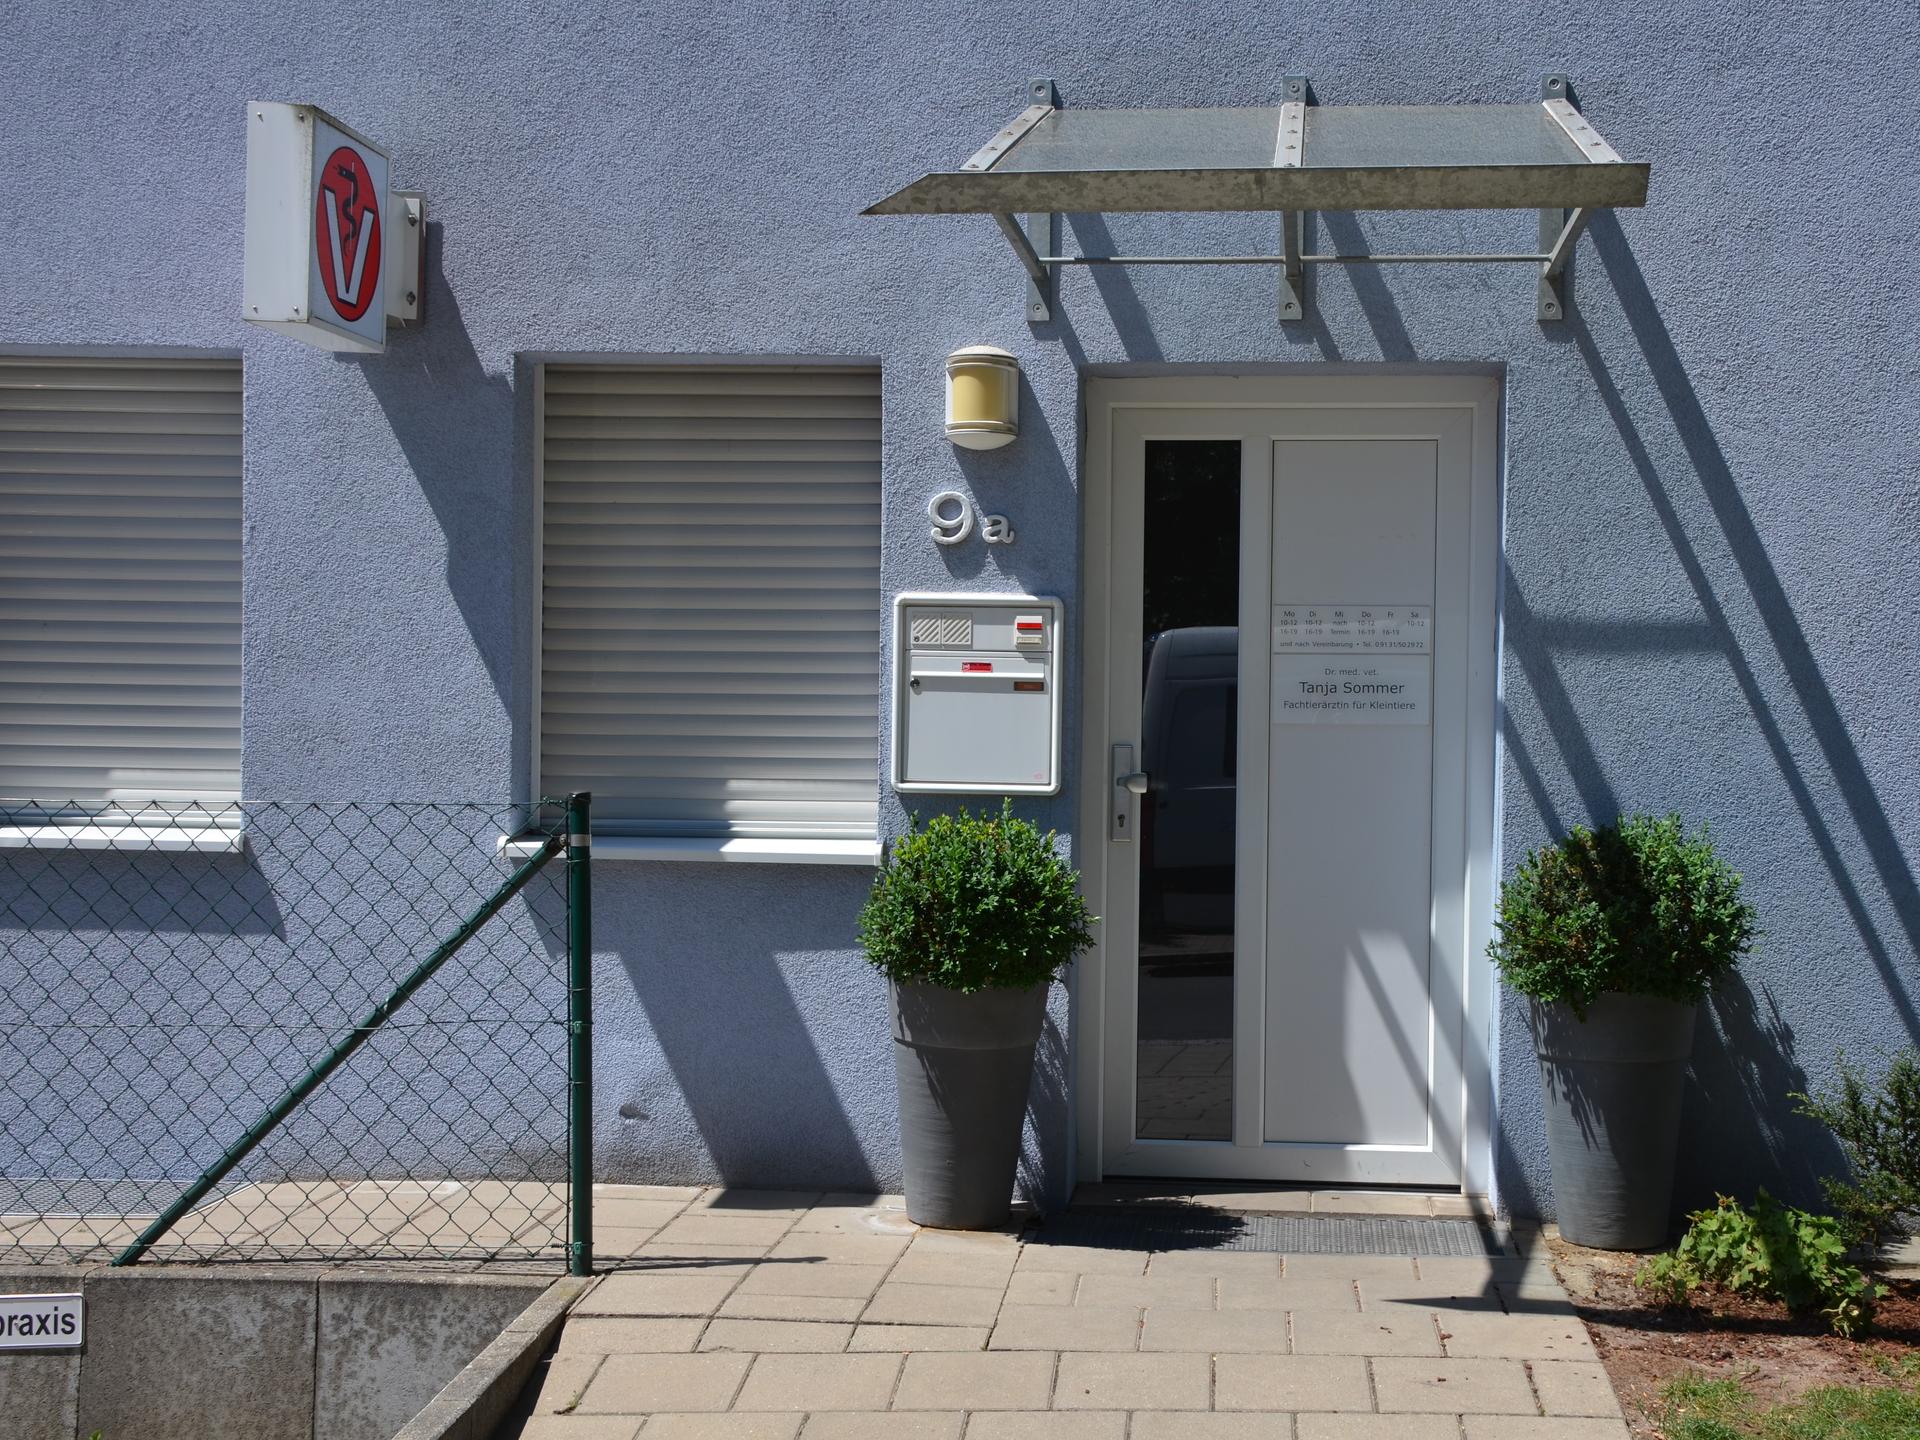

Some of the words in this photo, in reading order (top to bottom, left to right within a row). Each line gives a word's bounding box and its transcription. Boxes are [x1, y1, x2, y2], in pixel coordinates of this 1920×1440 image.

[1283, 610, 1296, 618] Mo
[1309, 610, 1317, 618] Di
[1334, 610, 1344, 618] Mi
[1312, 641, 1354, 649] Vereinbarung
[1324, 668, 1337, 676] Dr.
[1339, 668, 1360, 676] med.
[1364, 668, 1379, 676] vet.
[1299, 681, 1337, 696] Tanja
[1343, 681, 1405, 694] Sommer
[1283, 700, 1349, 710] Fachtierärztin
[1352, 700, 1366, 710] für
[1369, 700, 1416, 710] Kleintiere
